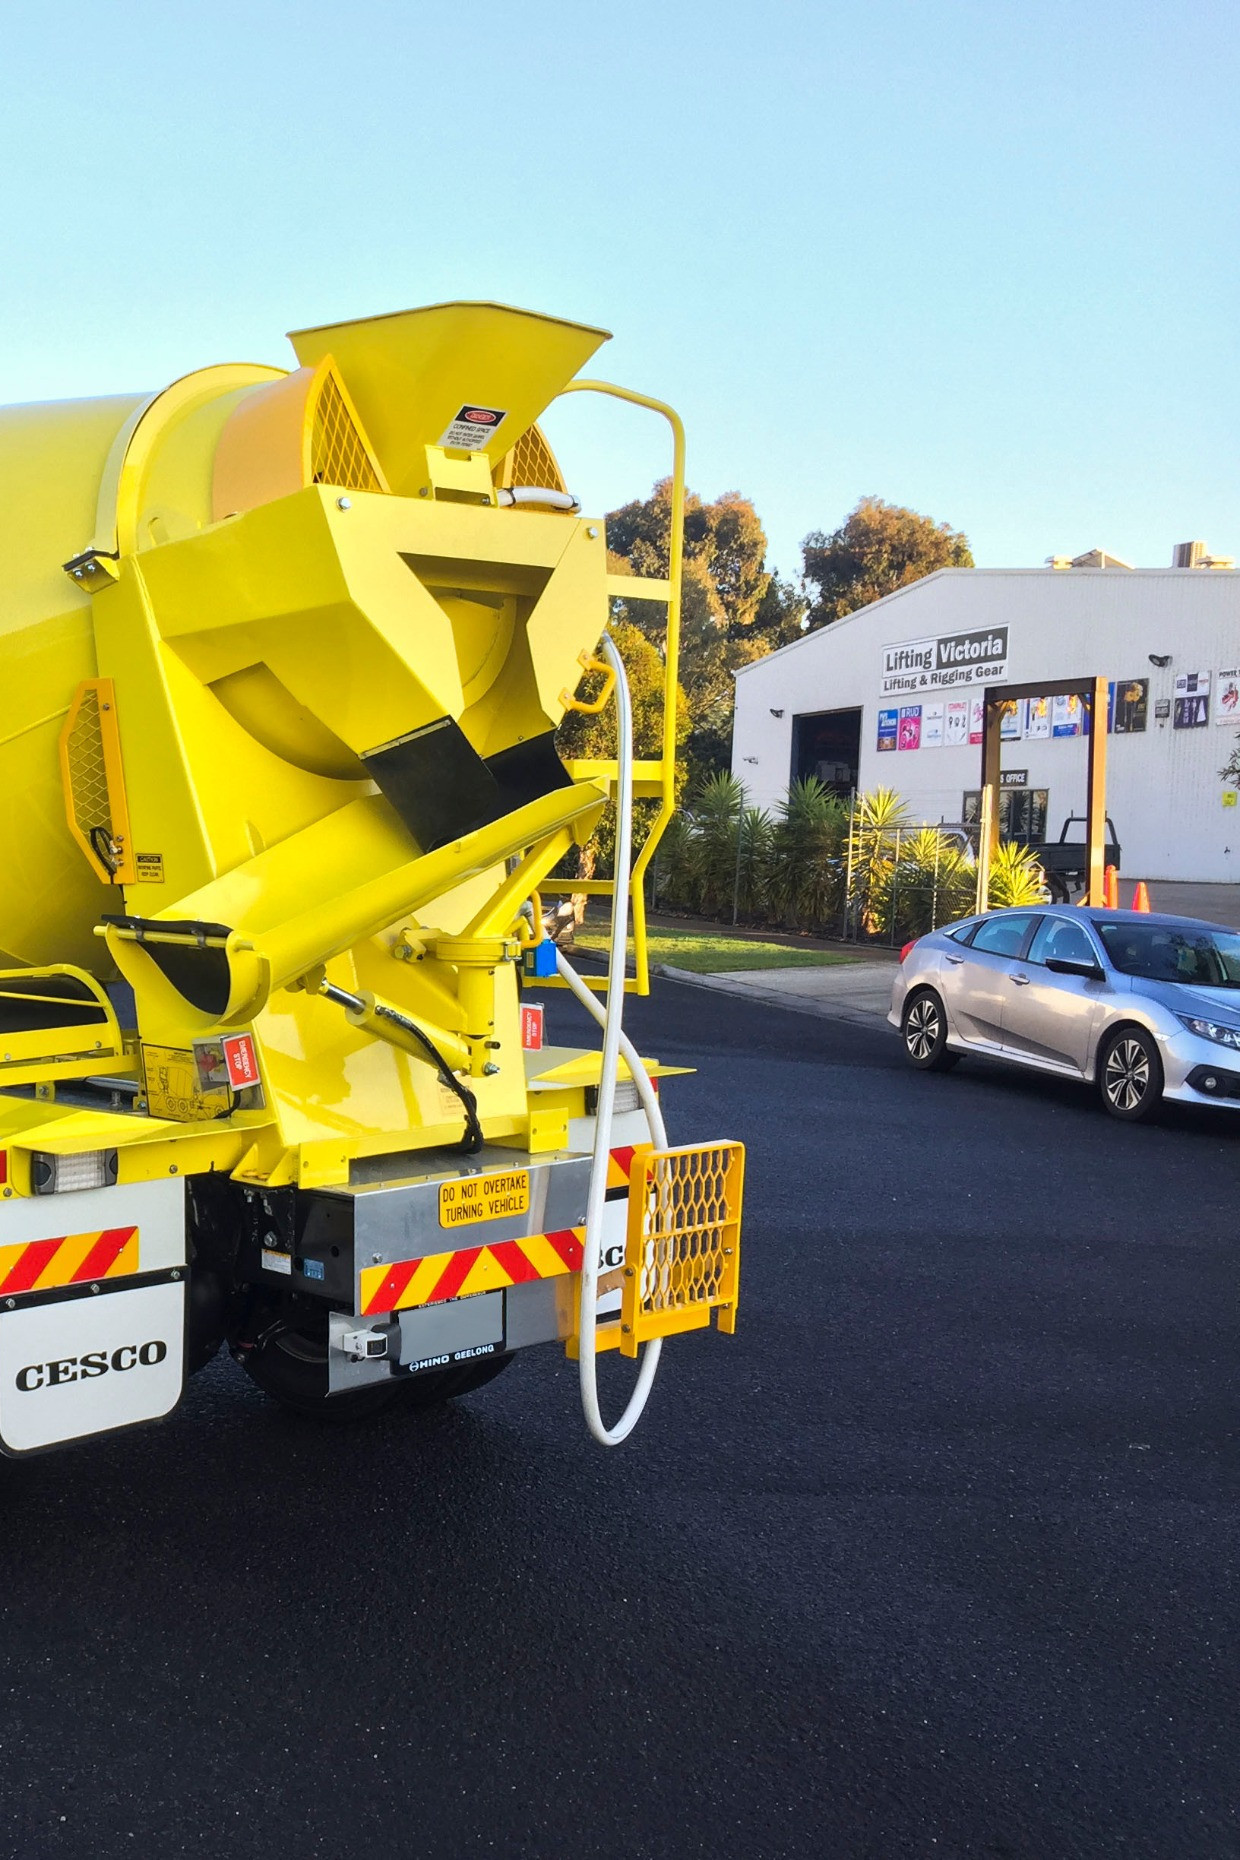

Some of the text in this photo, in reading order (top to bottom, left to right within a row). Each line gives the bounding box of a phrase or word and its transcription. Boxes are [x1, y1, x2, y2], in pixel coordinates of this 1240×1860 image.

[885, 634, 1003, 672] Lifting Victoria
[883, 665, 1004, 691] Lifting & Rigging Gear
[1006, 772, 1025, 783] OFFICE
[233, 1052, 243, 1070] STOP
[239, 1040, 252, 1078] EMERGENCY
[442, 1175, 527, 1203] DO NOT OVERTAKE
[446, 1195, 524, 1222] TURNING VEHICLE
[15, 1340, 167, 1392] CESCO
[419, 1344, 495, 1369] HINO GEELONG
